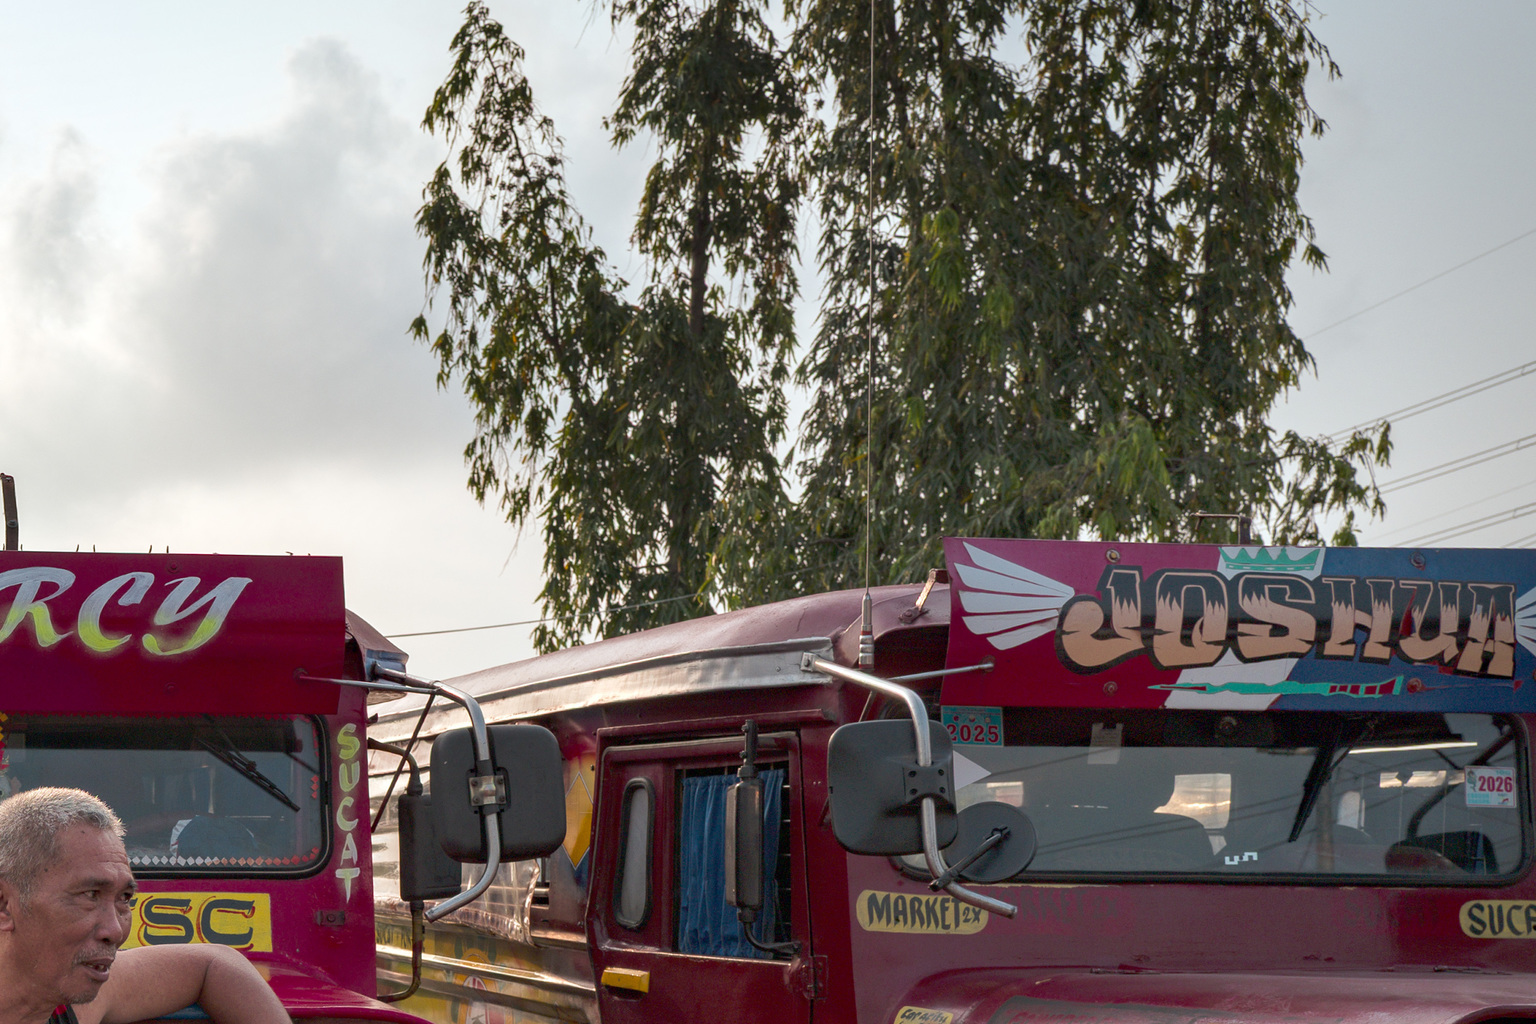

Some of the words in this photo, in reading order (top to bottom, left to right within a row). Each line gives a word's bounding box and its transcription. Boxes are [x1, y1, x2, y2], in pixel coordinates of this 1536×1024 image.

[1056, 565, 1516, 680] JOSHUA
[946, 723, 999, 743] 2025
[1478, 775, 1513, 793] 2026
[335, 722, 361, 904] SUCAT
[867, 892, 961, 931] MARKET
[961, 905, 982, 924] 2X
